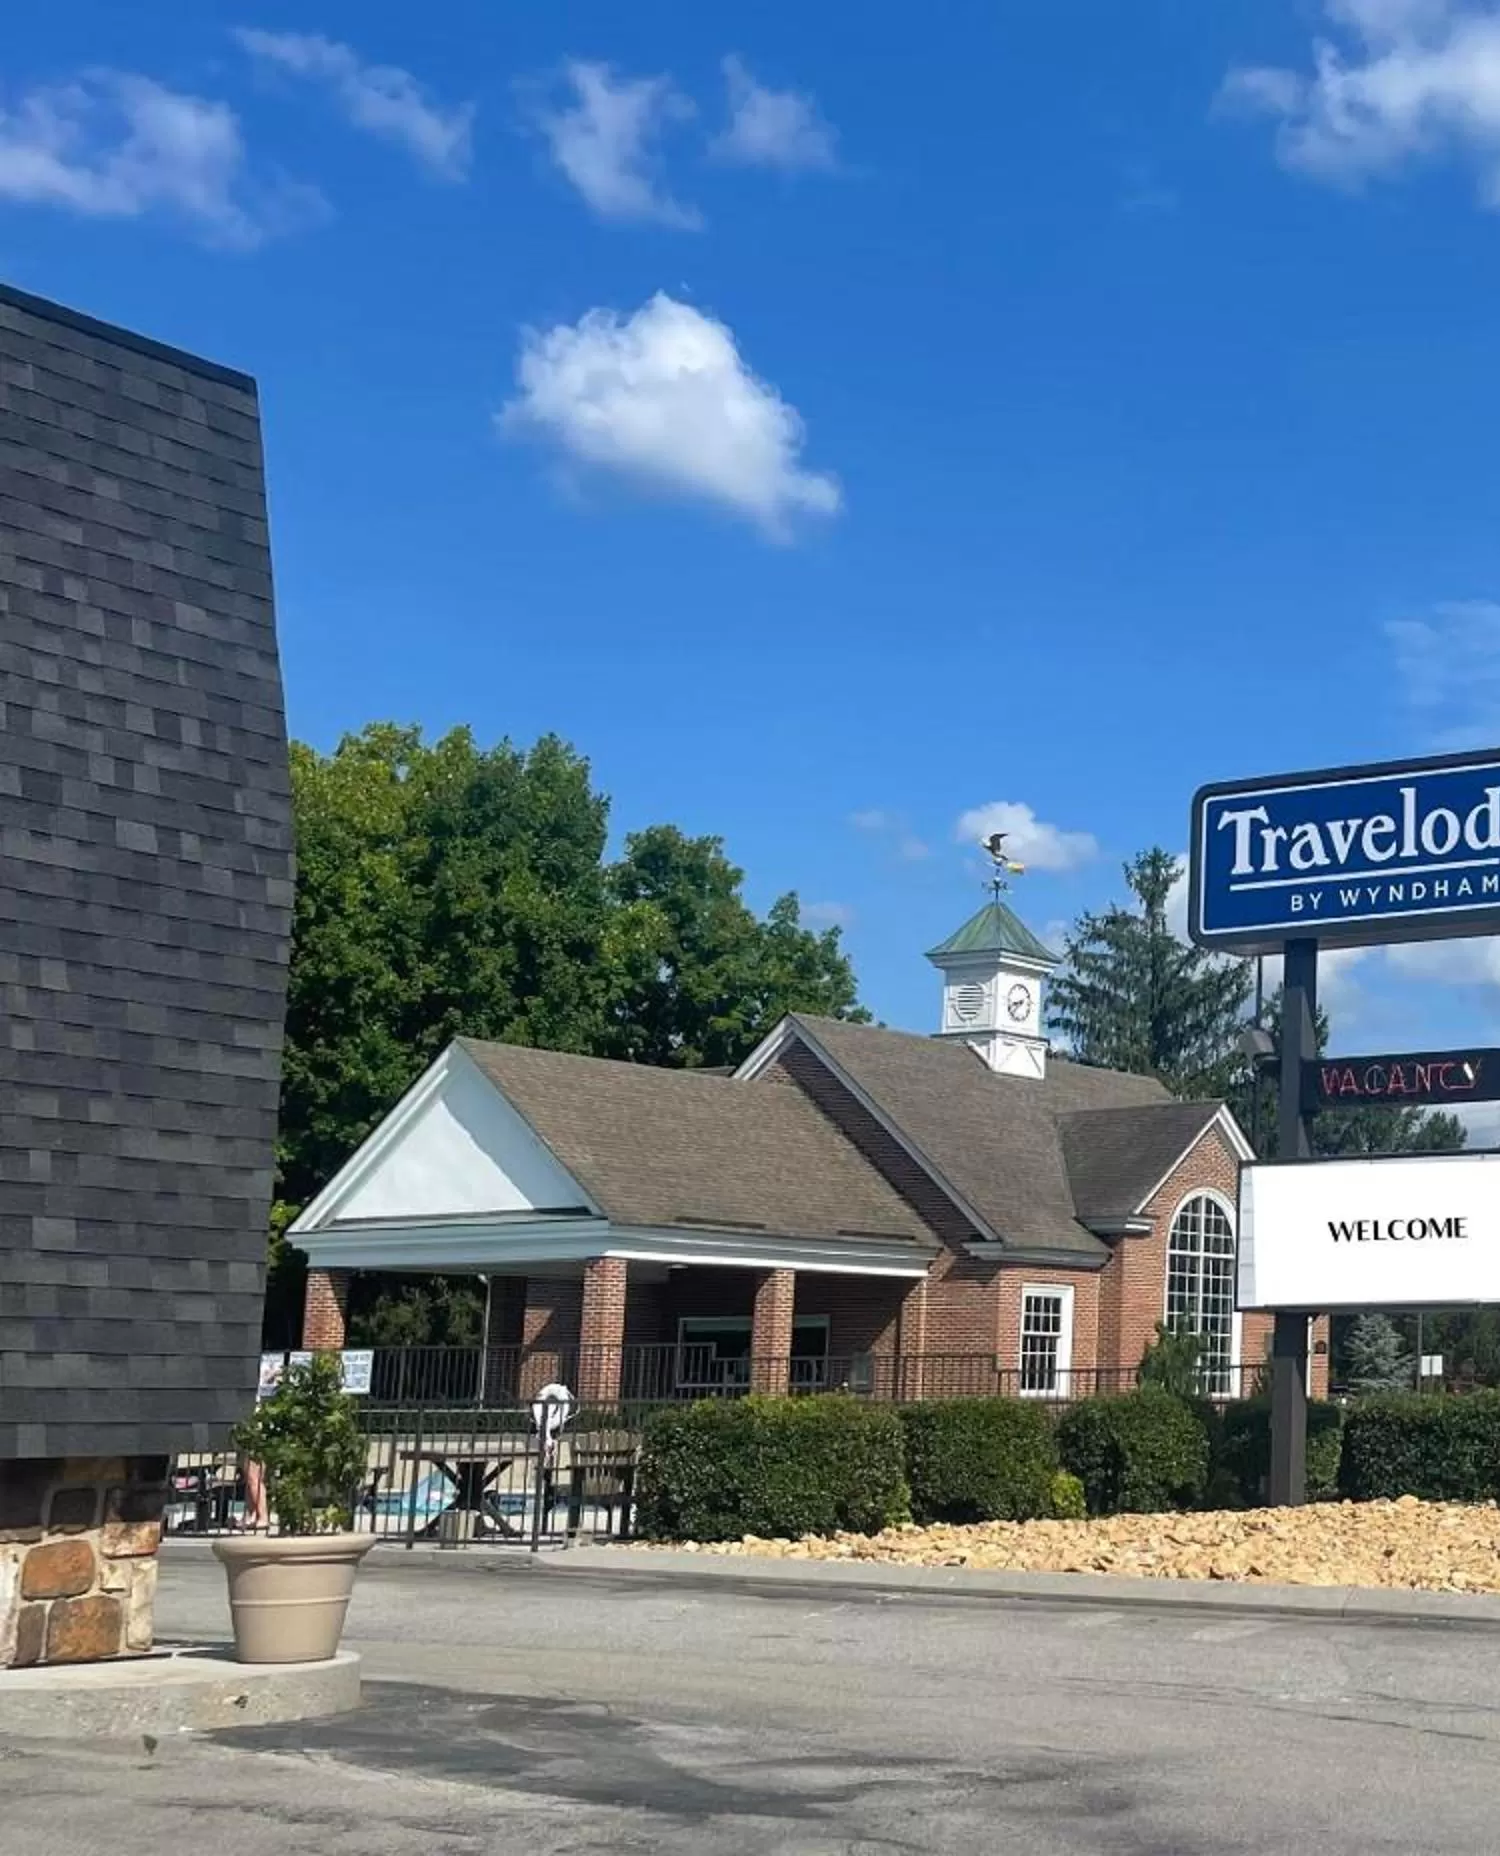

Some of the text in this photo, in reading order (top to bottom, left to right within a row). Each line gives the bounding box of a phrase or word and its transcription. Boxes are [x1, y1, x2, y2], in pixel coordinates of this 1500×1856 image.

[1291, 874, 1500, 912] BY WYNDHAM
[1321, 1059, 1482, 1096] VACANCY
[1328, 1217, 1469, 1243] WELCOME
